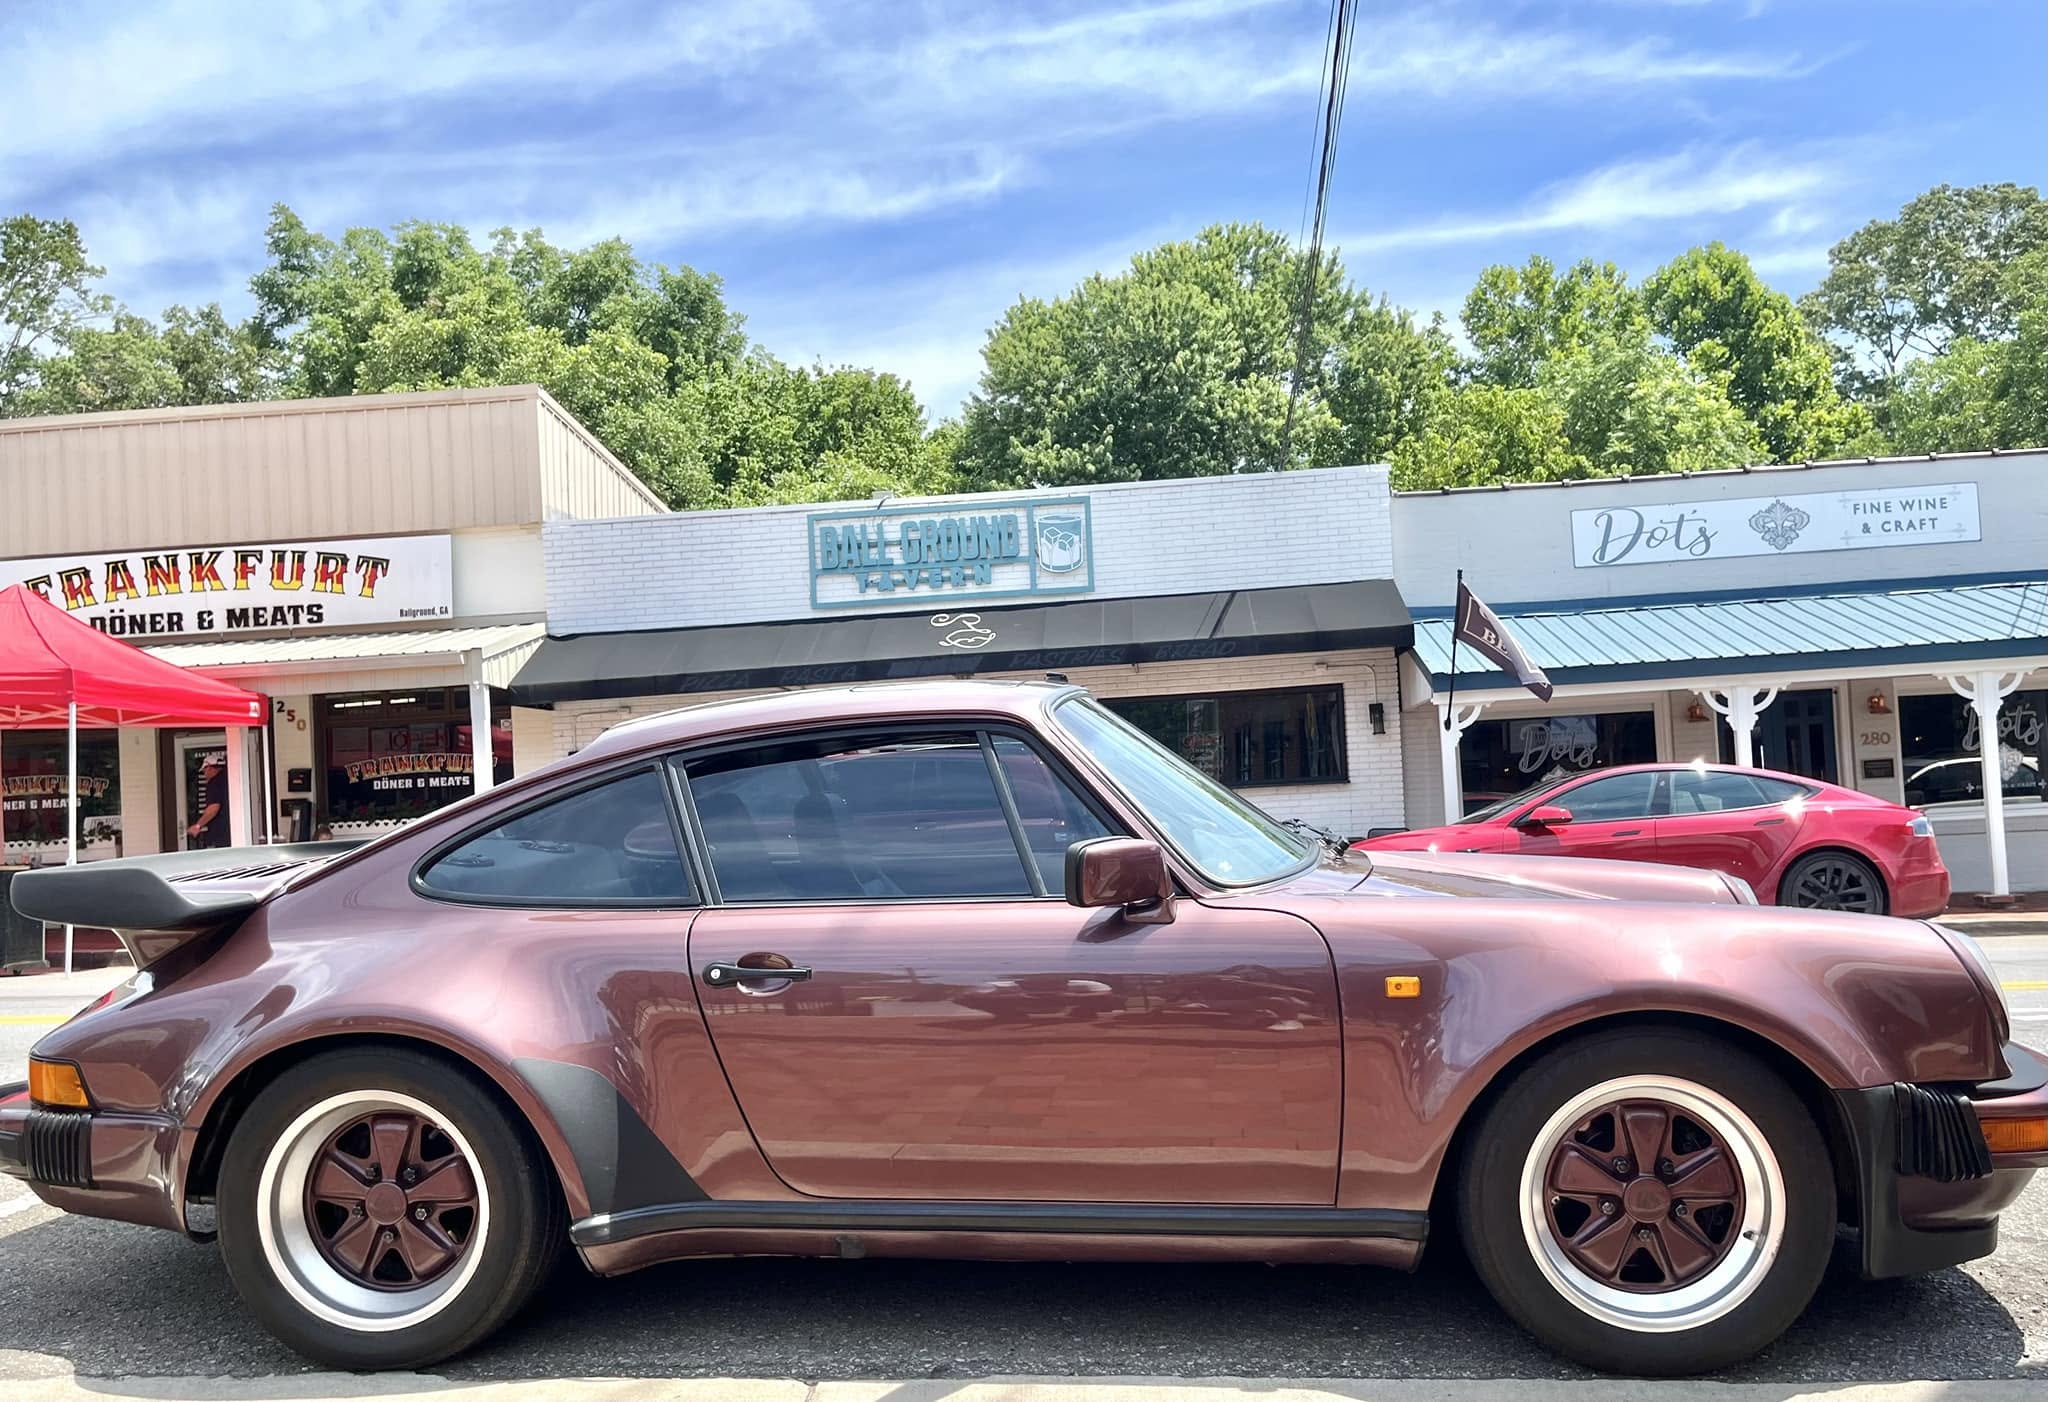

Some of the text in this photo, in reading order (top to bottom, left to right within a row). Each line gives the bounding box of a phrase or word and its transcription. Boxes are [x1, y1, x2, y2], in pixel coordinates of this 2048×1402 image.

[1853, 498, 1948, 515] FINE WINE
[1592, 507, 1719, 565] Dot's
[1861, 517, 1938, 534] & CRAFT
[819, 513, 1021, 570] BALL GROUND
[23, 550, 390, 611] FRANKFURT
[855, 563, 993, 594] TAVERN
[197, 610, 214, 630] &
[226, 603, 324, 629] MEATS
[439, 606, 449, 615] GA
[680, 641, 1237, 692] PIZZA PASTA PASTRIES BREAD
[276, 701, 307, 731] 250
[1860, 732, 1892, 746] 280
[373, 776, 470, 790] DÖNER & MEATS
[42, 798, 82, 809] MEAS
